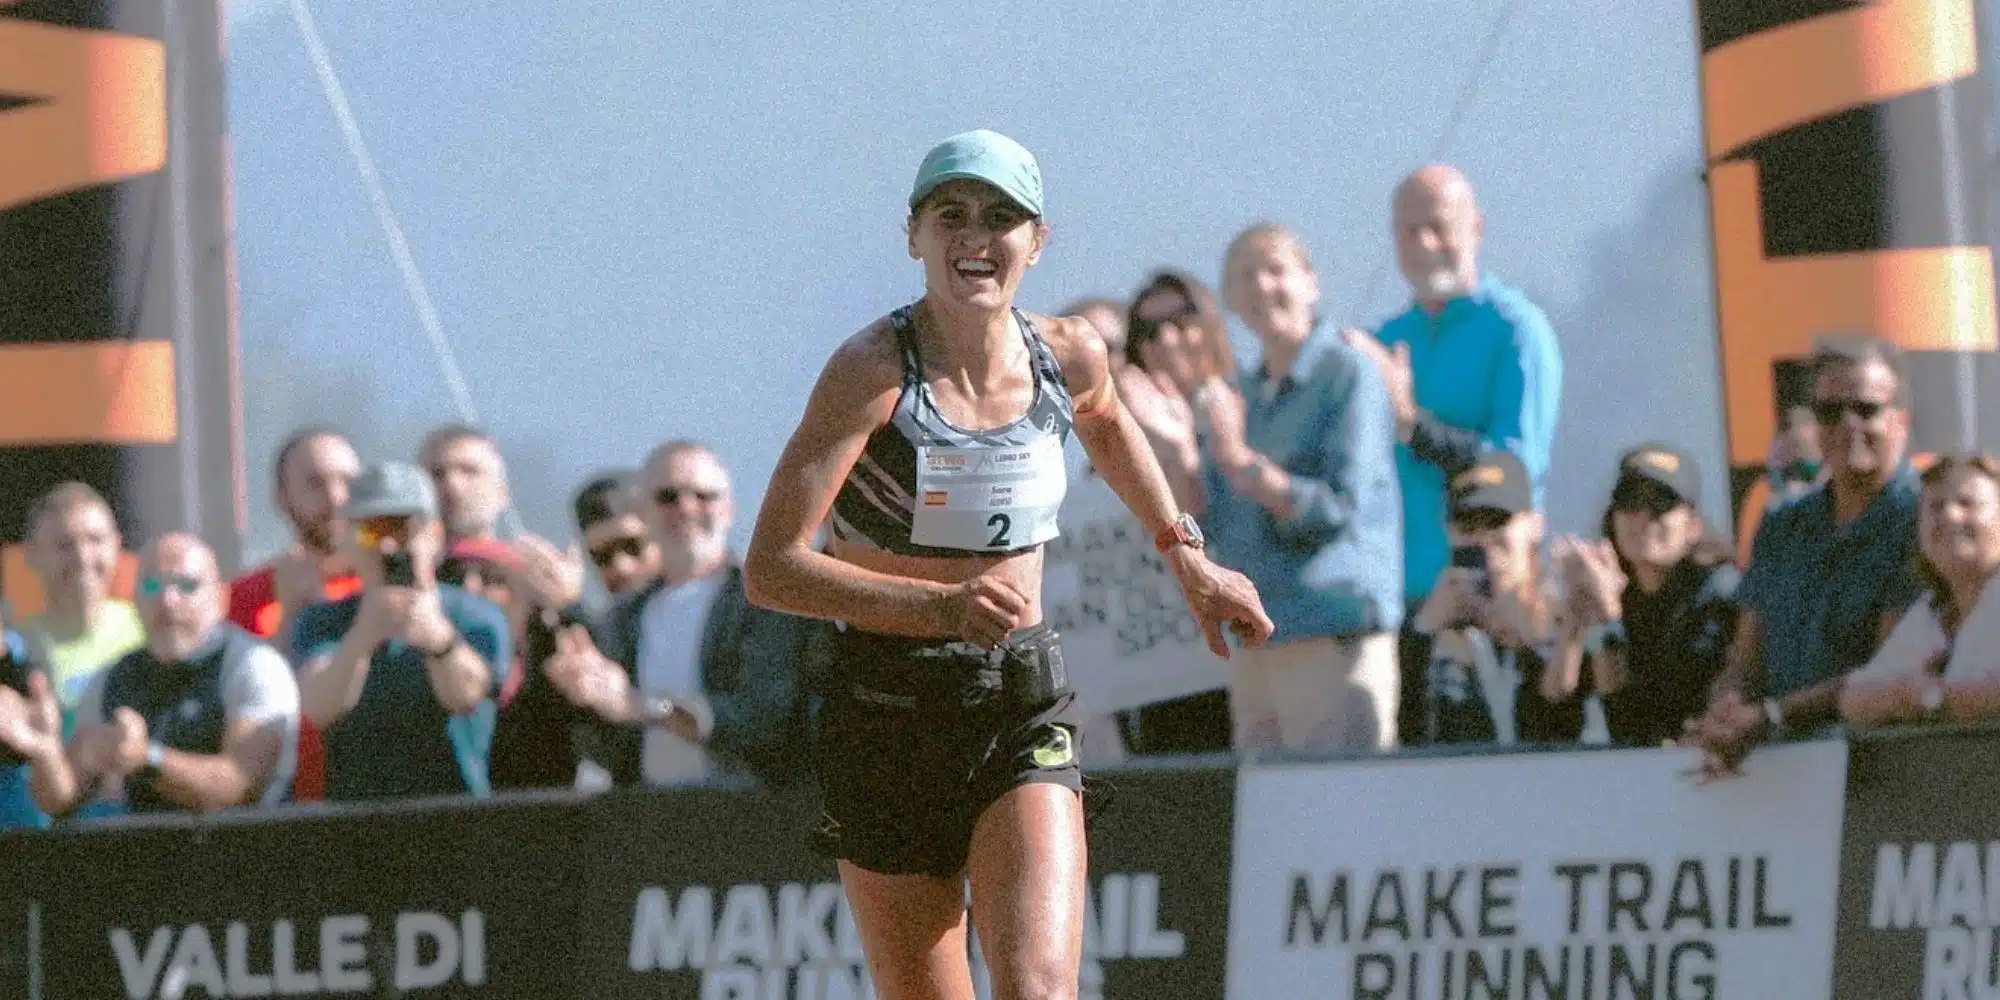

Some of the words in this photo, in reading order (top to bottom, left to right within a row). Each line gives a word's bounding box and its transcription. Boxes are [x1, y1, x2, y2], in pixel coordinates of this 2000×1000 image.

[1019, 452, 1031, 460] SKY
[987, 513, 1011, 547] 2
[1285, 866, 1520, 947] MAKE
[1554, 855, 1792, 934] TRAIL
[109, 914, 374, 1000] VALLE
[393, 907, 487, 990] DI
[1354, 940, 1720, 1000] RUNNING
